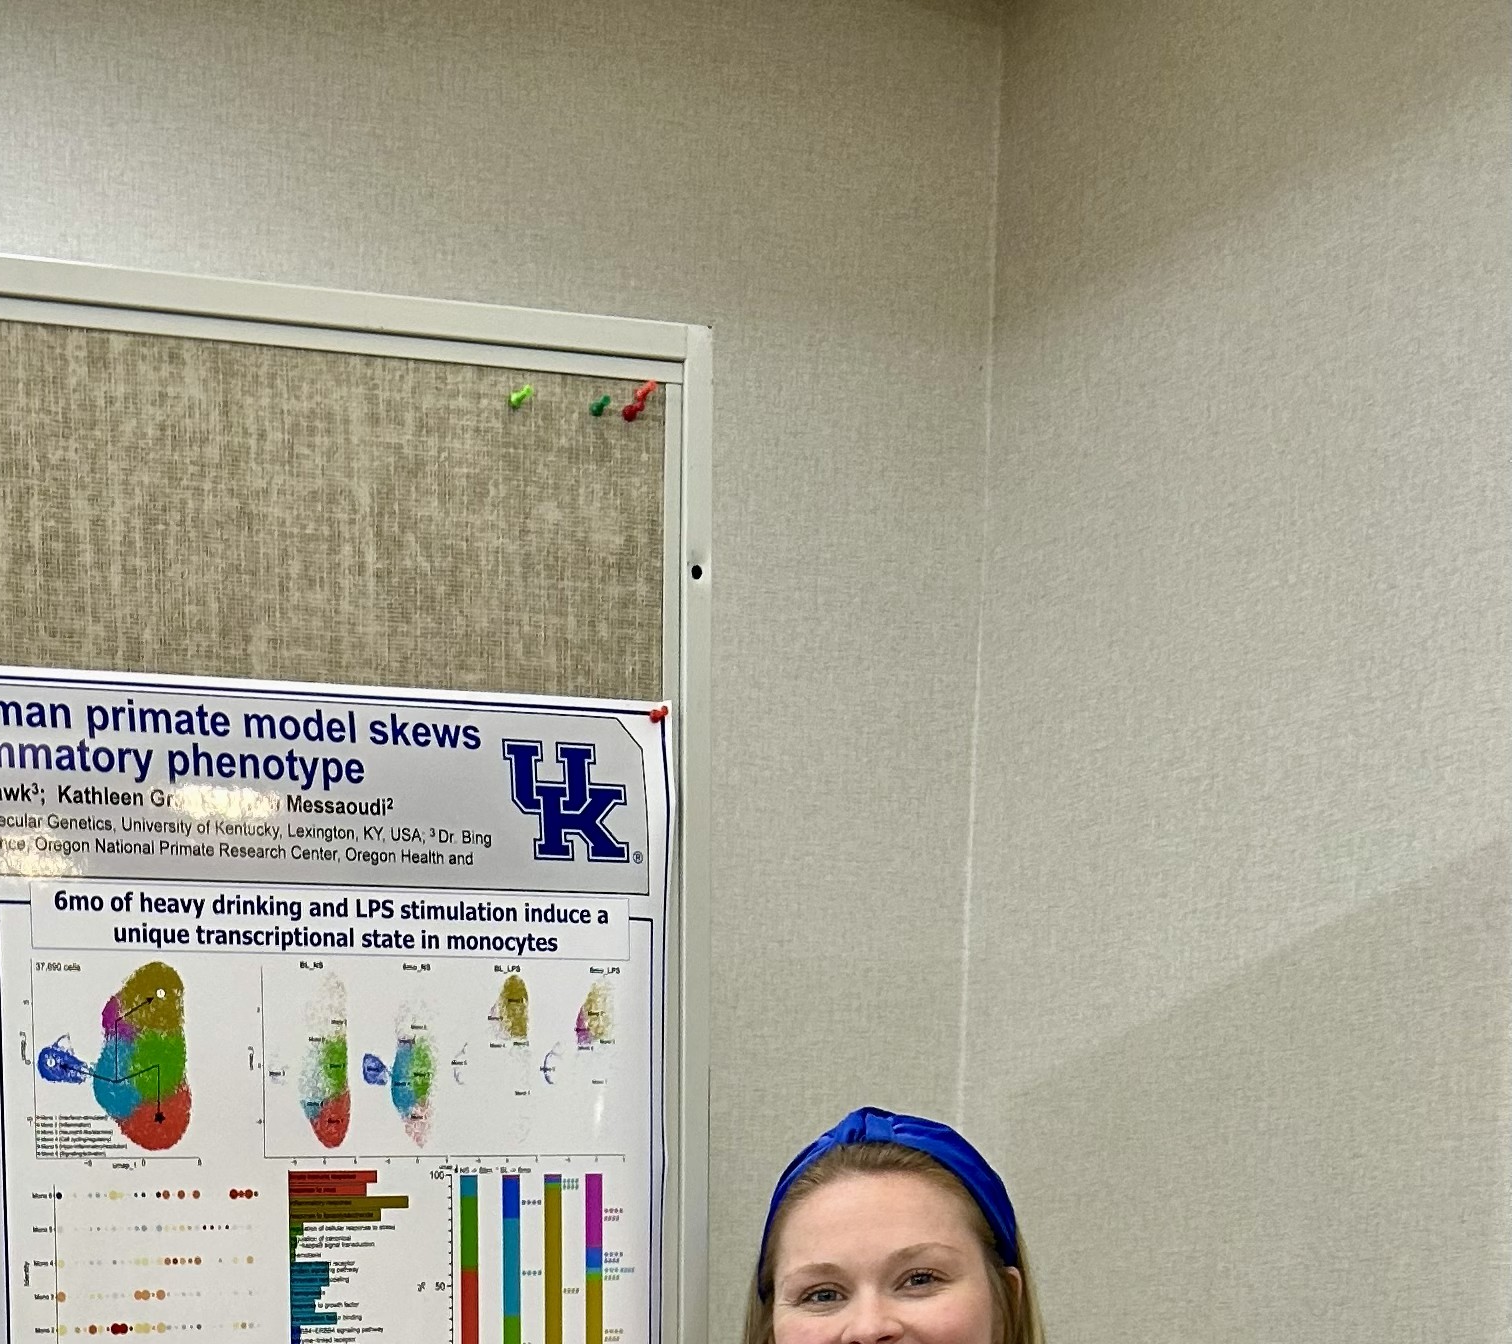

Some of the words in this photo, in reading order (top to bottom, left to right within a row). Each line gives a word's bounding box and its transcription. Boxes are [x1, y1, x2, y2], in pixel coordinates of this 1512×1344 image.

[86, 696, 231, 742] primate
[243, 701, 357, 743] model
[369, 706, 482, 749] skews
[167, 744, 365, 789] phenotype
[57, 778, 144, 807] Kathleen
[54, 889, 104, 912] 6mo
[110, 891, 134, 913] of
[139, 891, 206, 920] heavy
[212, 893, 302, 922] drinking
[309, 897, 349, 918] and
[355, 898, 395, 920] LPS
[400, 899, 518, 922] stimulation
[524, 902, 592, 924] induce
[597, 909, 609, 925] a
[113, 922, 190, 949] unique
[195, 925, 355, 952] transcriptional
[361, 929, 415, 950] state
[420, 929, 440, 950] in
[446, 932, 558, 956] monocytes
